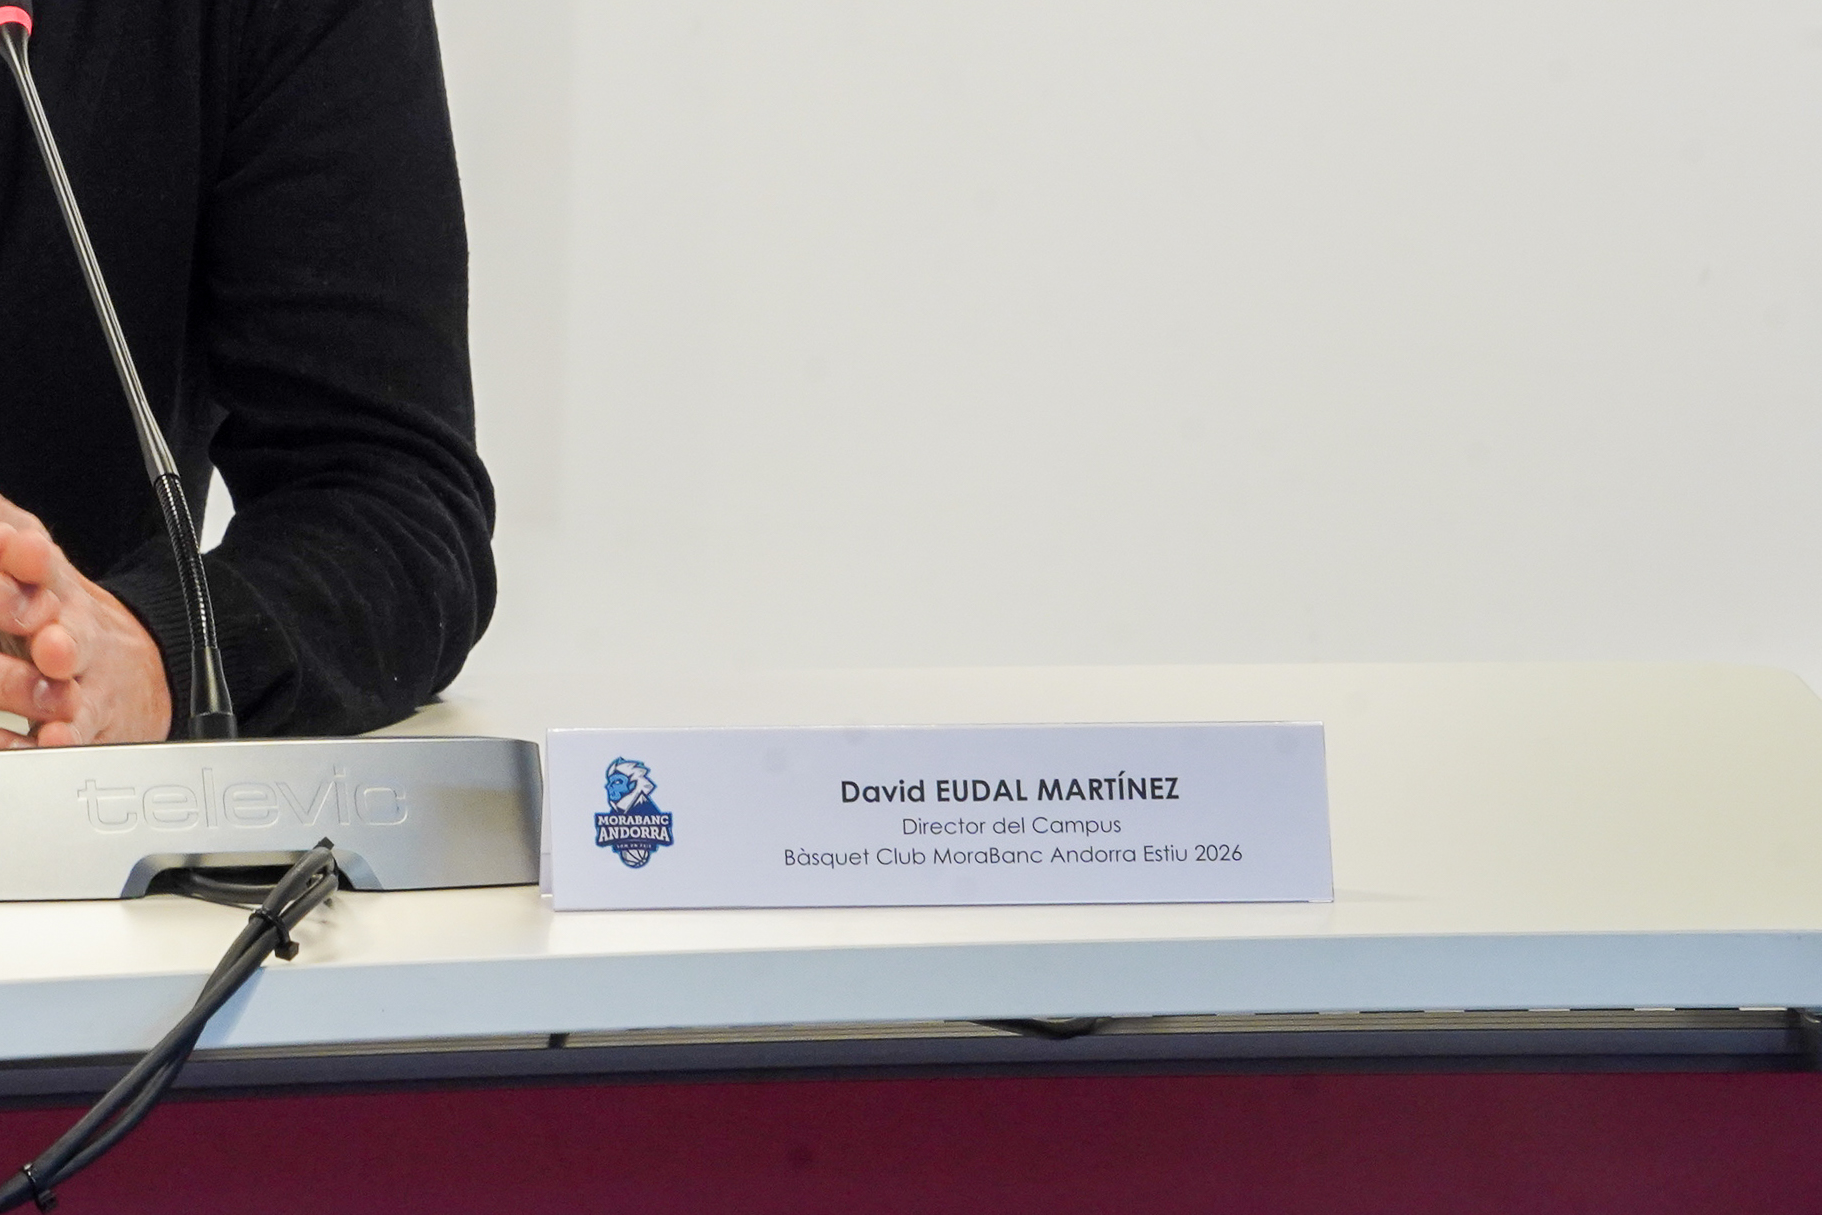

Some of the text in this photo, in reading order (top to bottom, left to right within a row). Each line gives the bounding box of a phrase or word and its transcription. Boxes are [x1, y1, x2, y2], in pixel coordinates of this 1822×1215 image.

[840, 770, 1180, 803] David EUDAL MARTÍNEZ
[77, 764, 409, 834] televic
[598, 815, 669, 826] MORABANC
[902, 816, 1122, 837] Director del Campus
[598, 826, 670, 843] ANDORRA
[784, 844, 1243, 870] Bàsquet Club MoraBanc Andorra Estiu 2026
